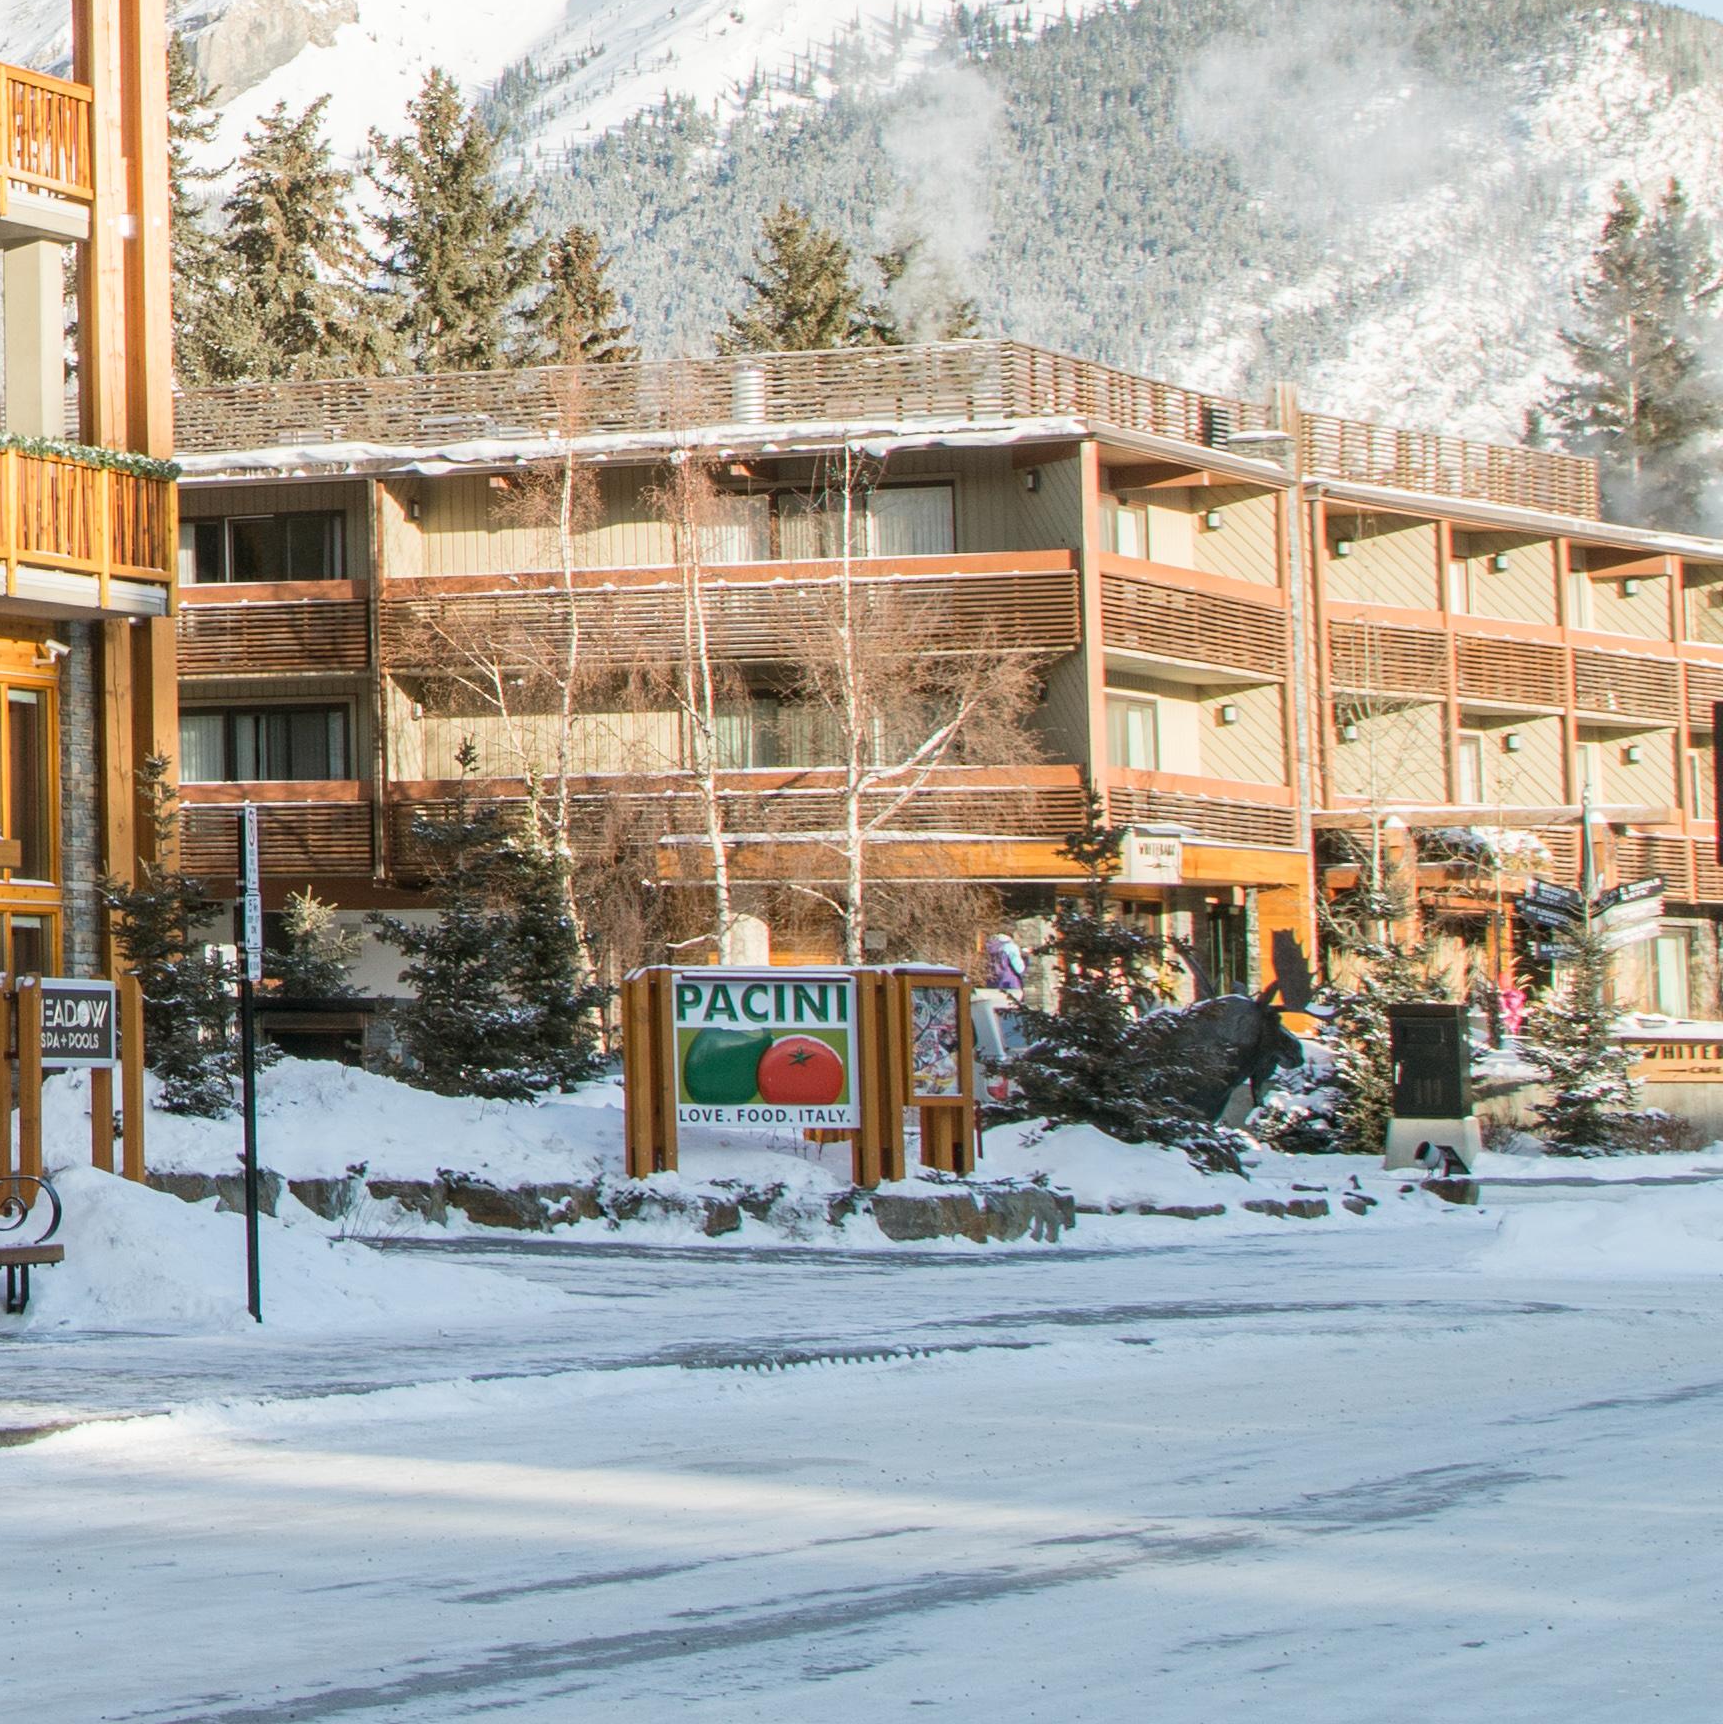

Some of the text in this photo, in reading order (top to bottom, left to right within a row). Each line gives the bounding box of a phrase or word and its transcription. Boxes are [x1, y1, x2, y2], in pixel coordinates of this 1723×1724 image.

[40, 998, 108, 1028] EADOW
[676, 983, 848, 1023] PACINI
[40, 1032, 60, 1048] SPA
[68, 1032, 100, 1049] POOLS
[679, 1108, 852, 1123] LOVE. FOOD. ITALY.
